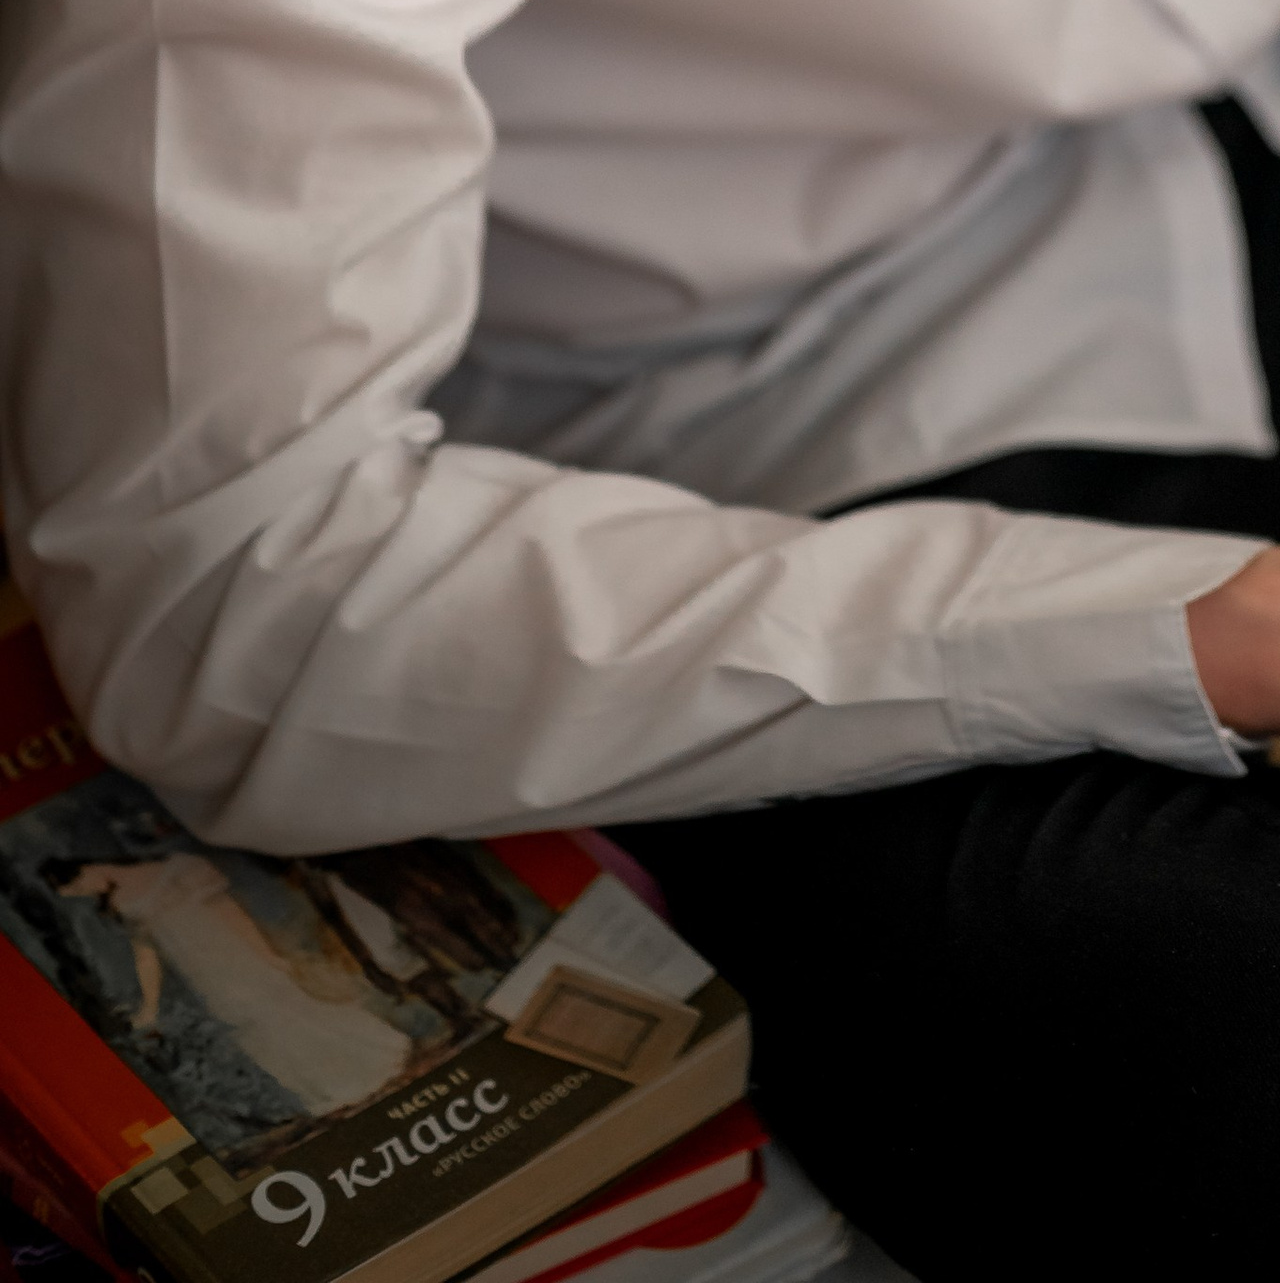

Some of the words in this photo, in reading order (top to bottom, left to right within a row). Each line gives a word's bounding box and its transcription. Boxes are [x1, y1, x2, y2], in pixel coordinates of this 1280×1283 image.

[387, 1082, 450, 1121] ЧАСТЬ
[251, 1170, 326, 1248] 9
[328, 1078, 508, 1199] класс
[432, 1118, 521, 1178] «РУССКОЕ
